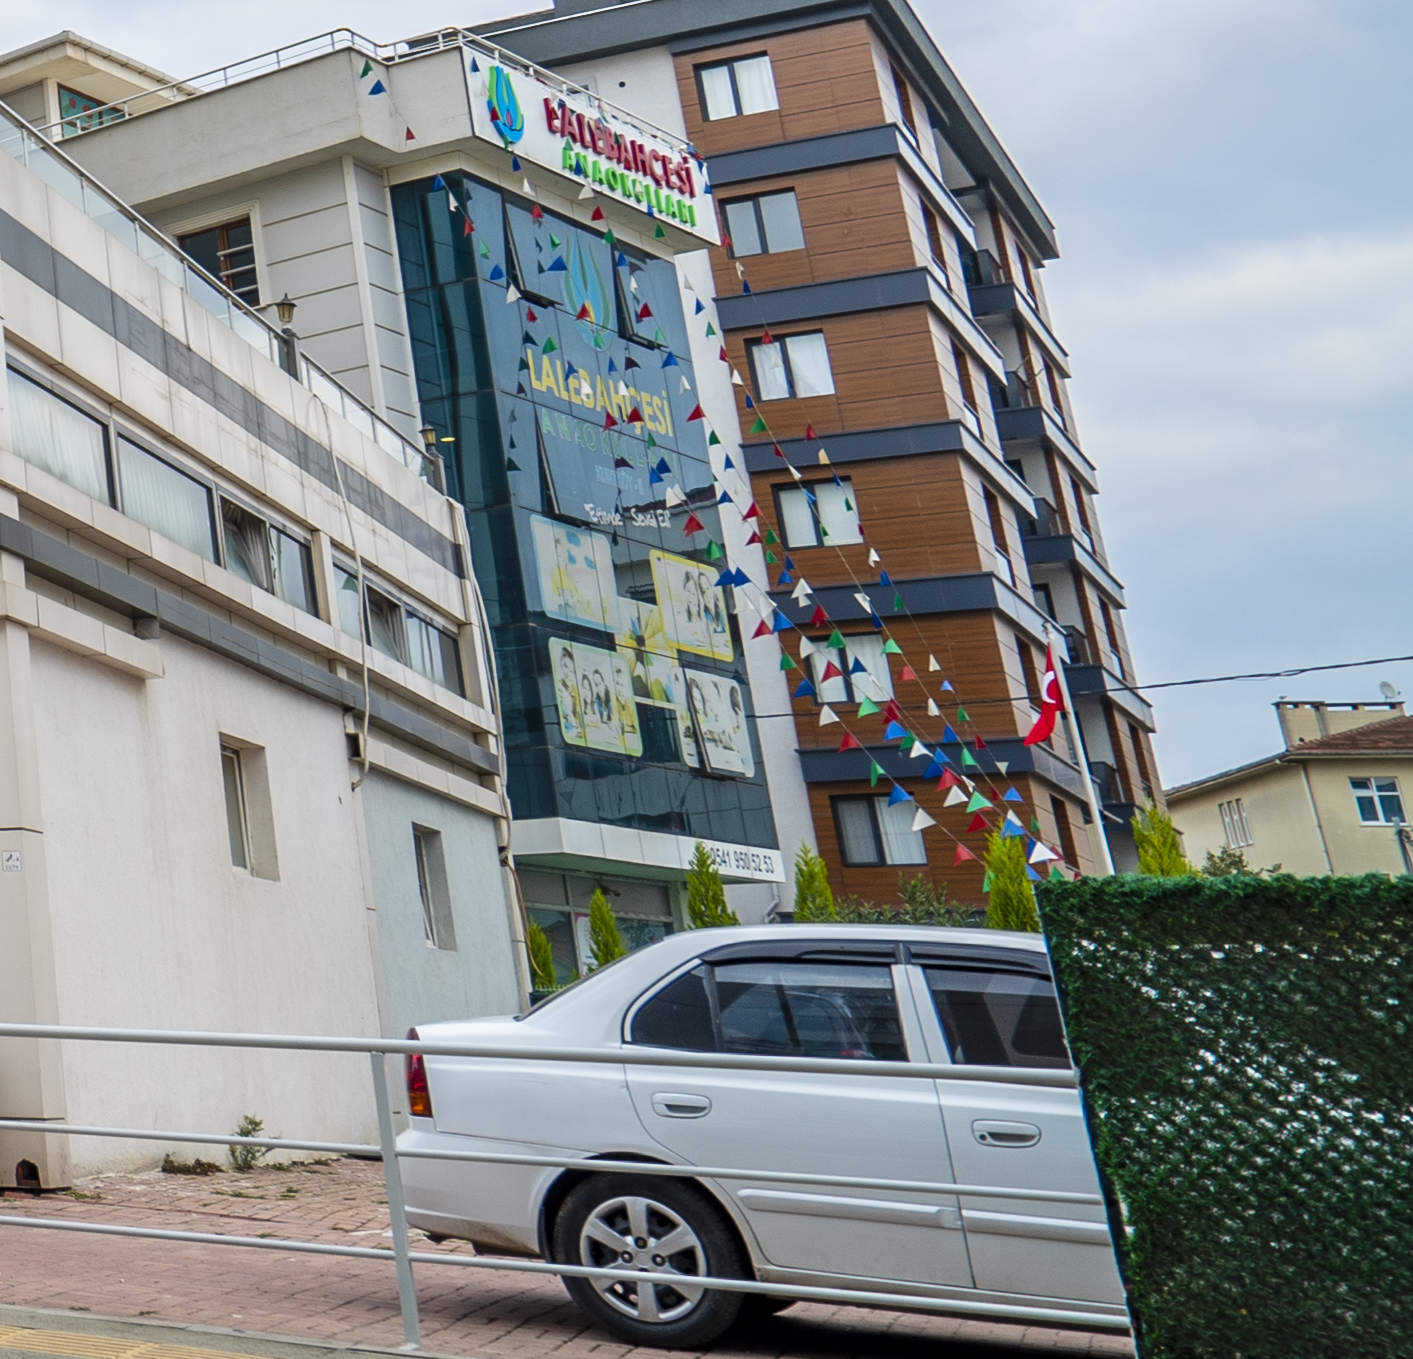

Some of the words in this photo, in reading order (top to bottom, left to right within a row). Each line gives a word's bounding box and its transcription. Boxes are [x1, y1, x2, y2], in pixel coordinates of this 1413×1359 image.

[733, 850, 750, 870] 950
[751, 853, 763, 872] 52
[763, 855, 775, 874] 53
